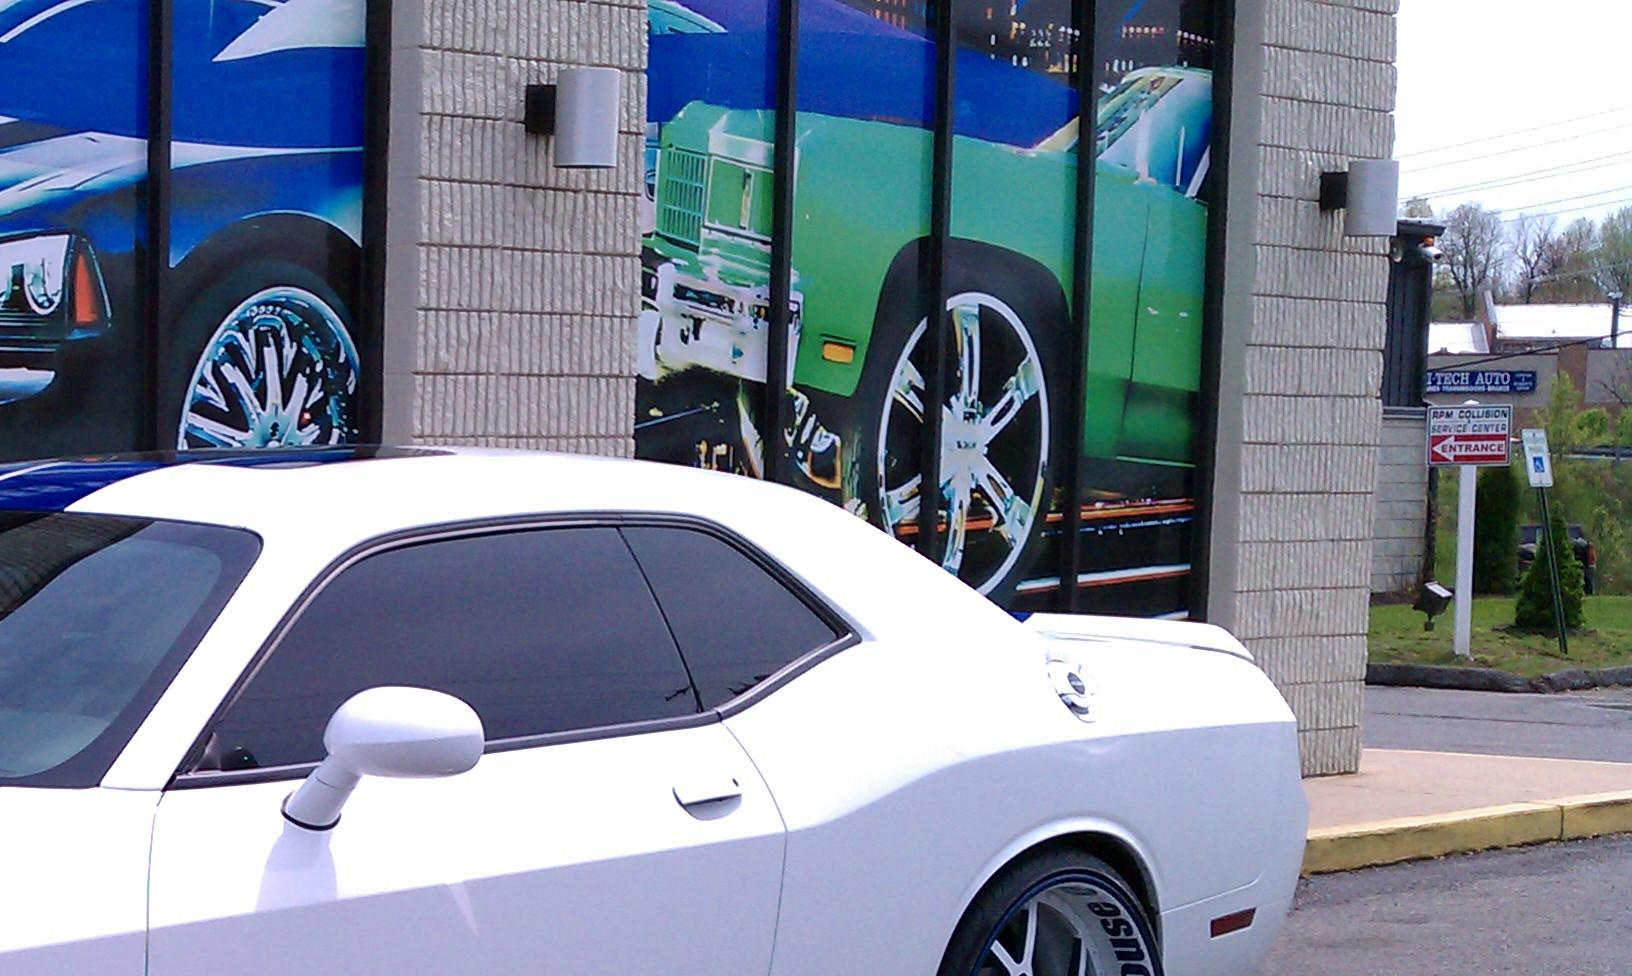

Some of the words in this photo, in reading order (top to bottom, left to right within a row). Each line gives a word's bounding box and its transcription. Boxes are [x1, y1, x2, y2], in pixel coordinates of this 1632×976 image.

[1426, 372, 1470, 385] I-TECH
[1475, 372, 1511, 385] AUTO
[1432, 410, 1454, 419] RPM
[1458, 410, 1507, 419] COLLISION
[1432, 423, 1467, 433] SERVICE
[1471, 423, 1506, 432] CENTER
[1441, 443, 1504, 453] ENTRANCE
